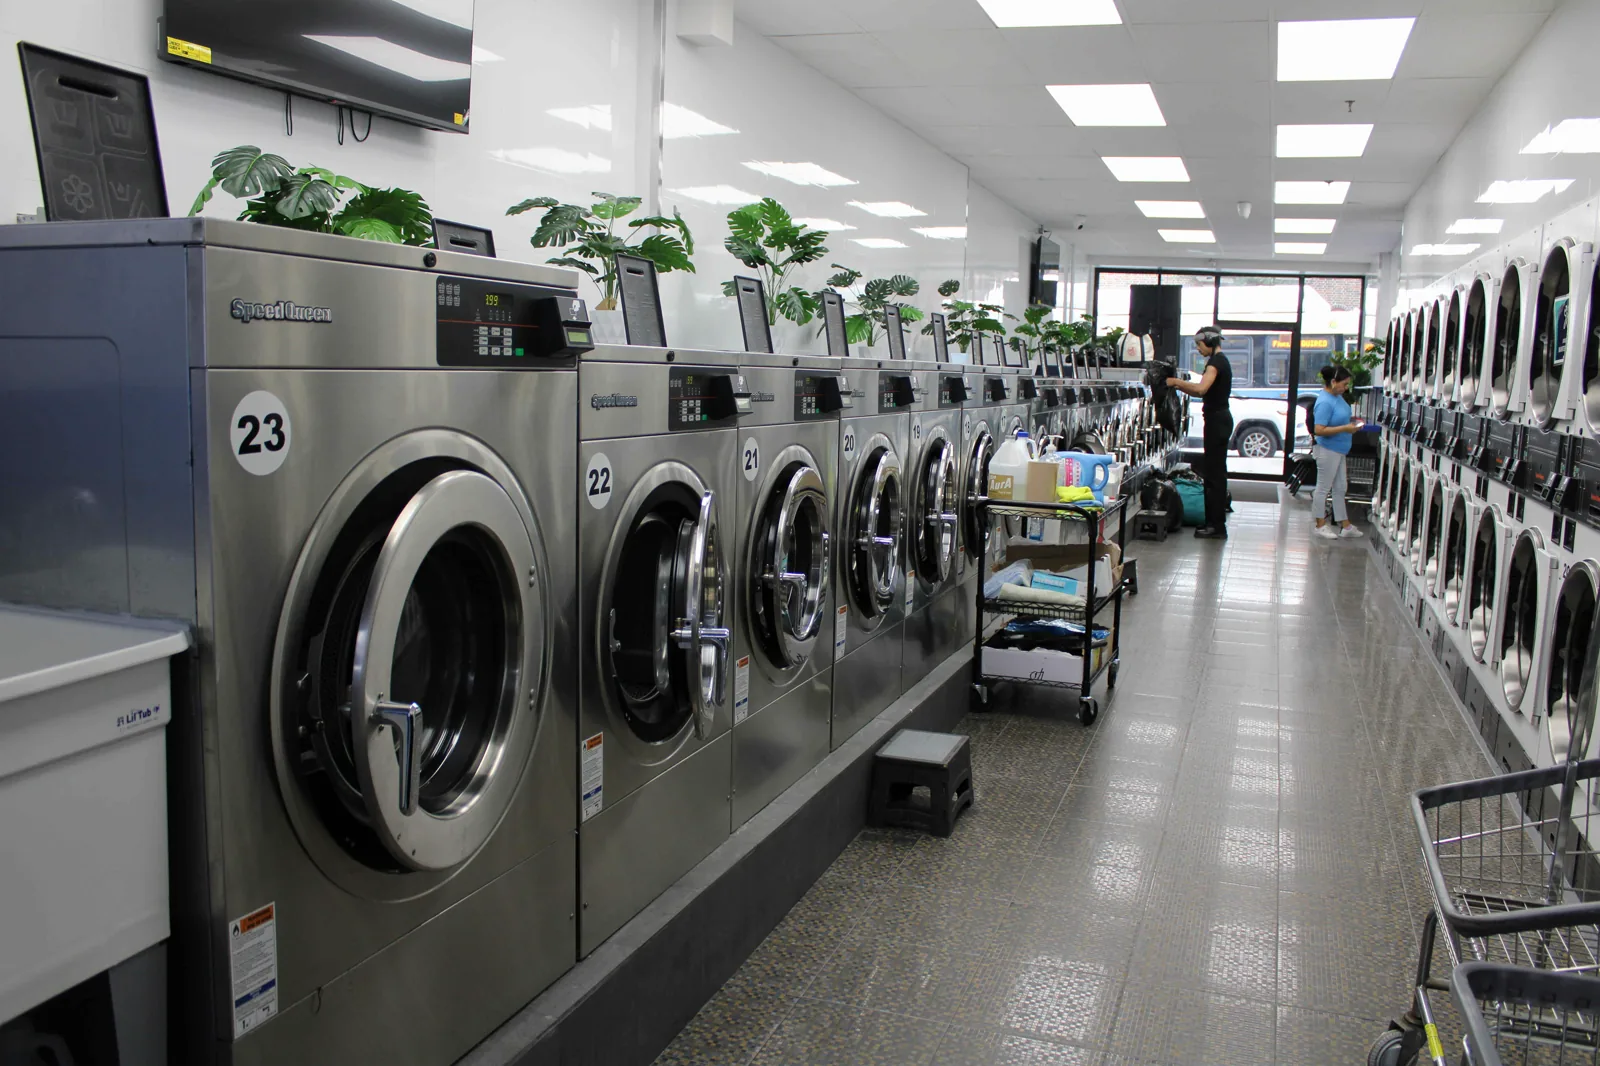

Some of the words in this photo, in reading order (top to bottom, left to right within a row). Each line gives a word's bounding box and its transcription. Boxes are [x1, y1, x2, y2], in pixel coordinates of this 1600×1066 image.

[1301, 339, 1328, 348] QUIRED
[238, 412, 286, 455] 23
[913, 424, 921, 439] 19
[844, 434, 855, 452] 20
[745, 448, 758, 471] 21
[588, 467, 611, 496] 22
